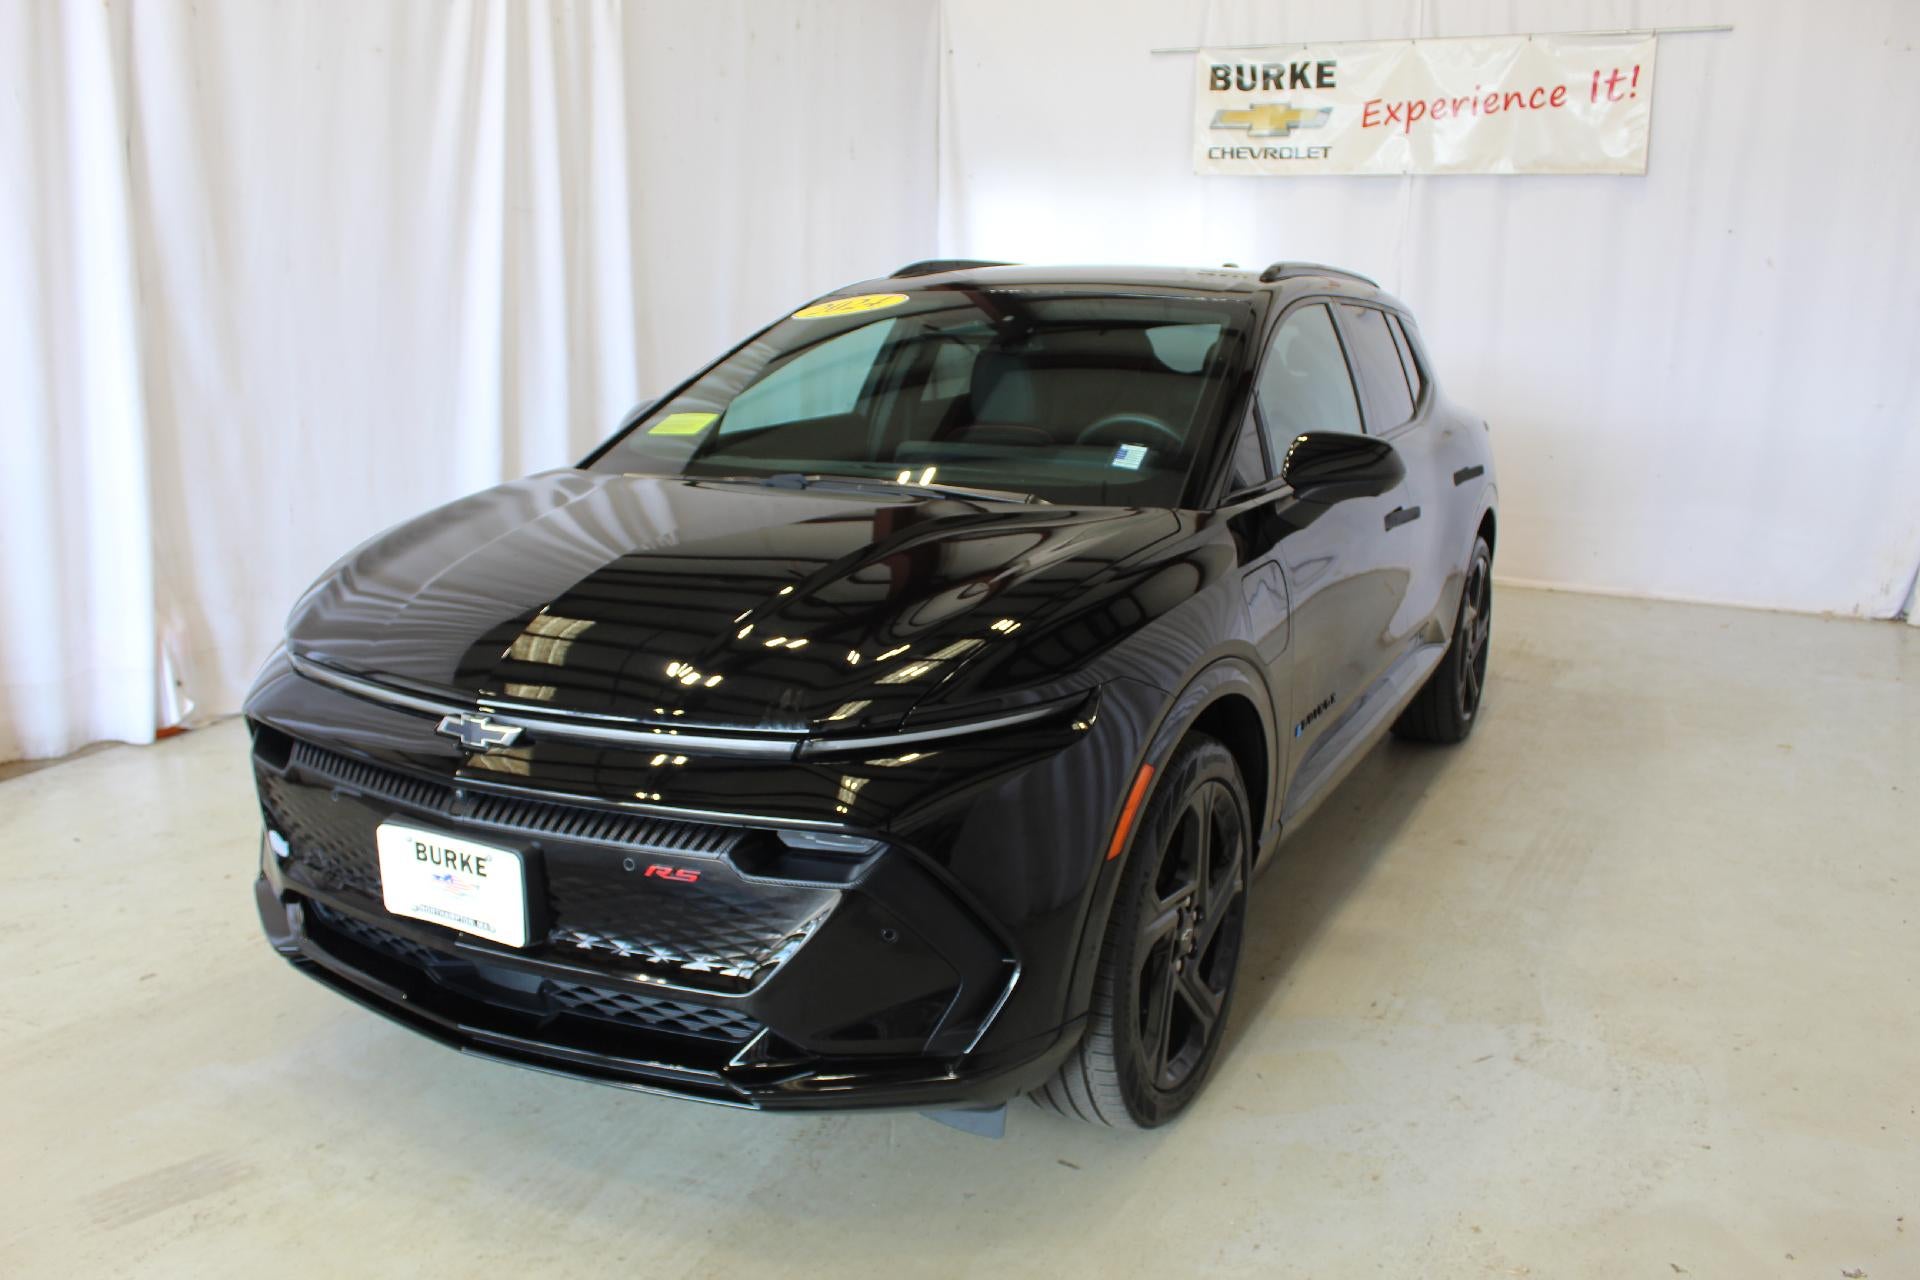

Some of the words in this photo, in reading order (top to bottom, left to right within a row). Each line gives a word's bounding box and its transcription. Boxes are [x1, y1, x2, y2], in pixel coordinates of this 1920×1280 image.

[1209, 60, 1337, 91] BURKE
[1361, 83, 1567, 134] Experience
[1590, 64, 1640, 105] It!
[1208, 145, 1333, 160] CHEVROLET
[415, 841, 488, 878] BURKE
[643, 864, 701, 884] RS
